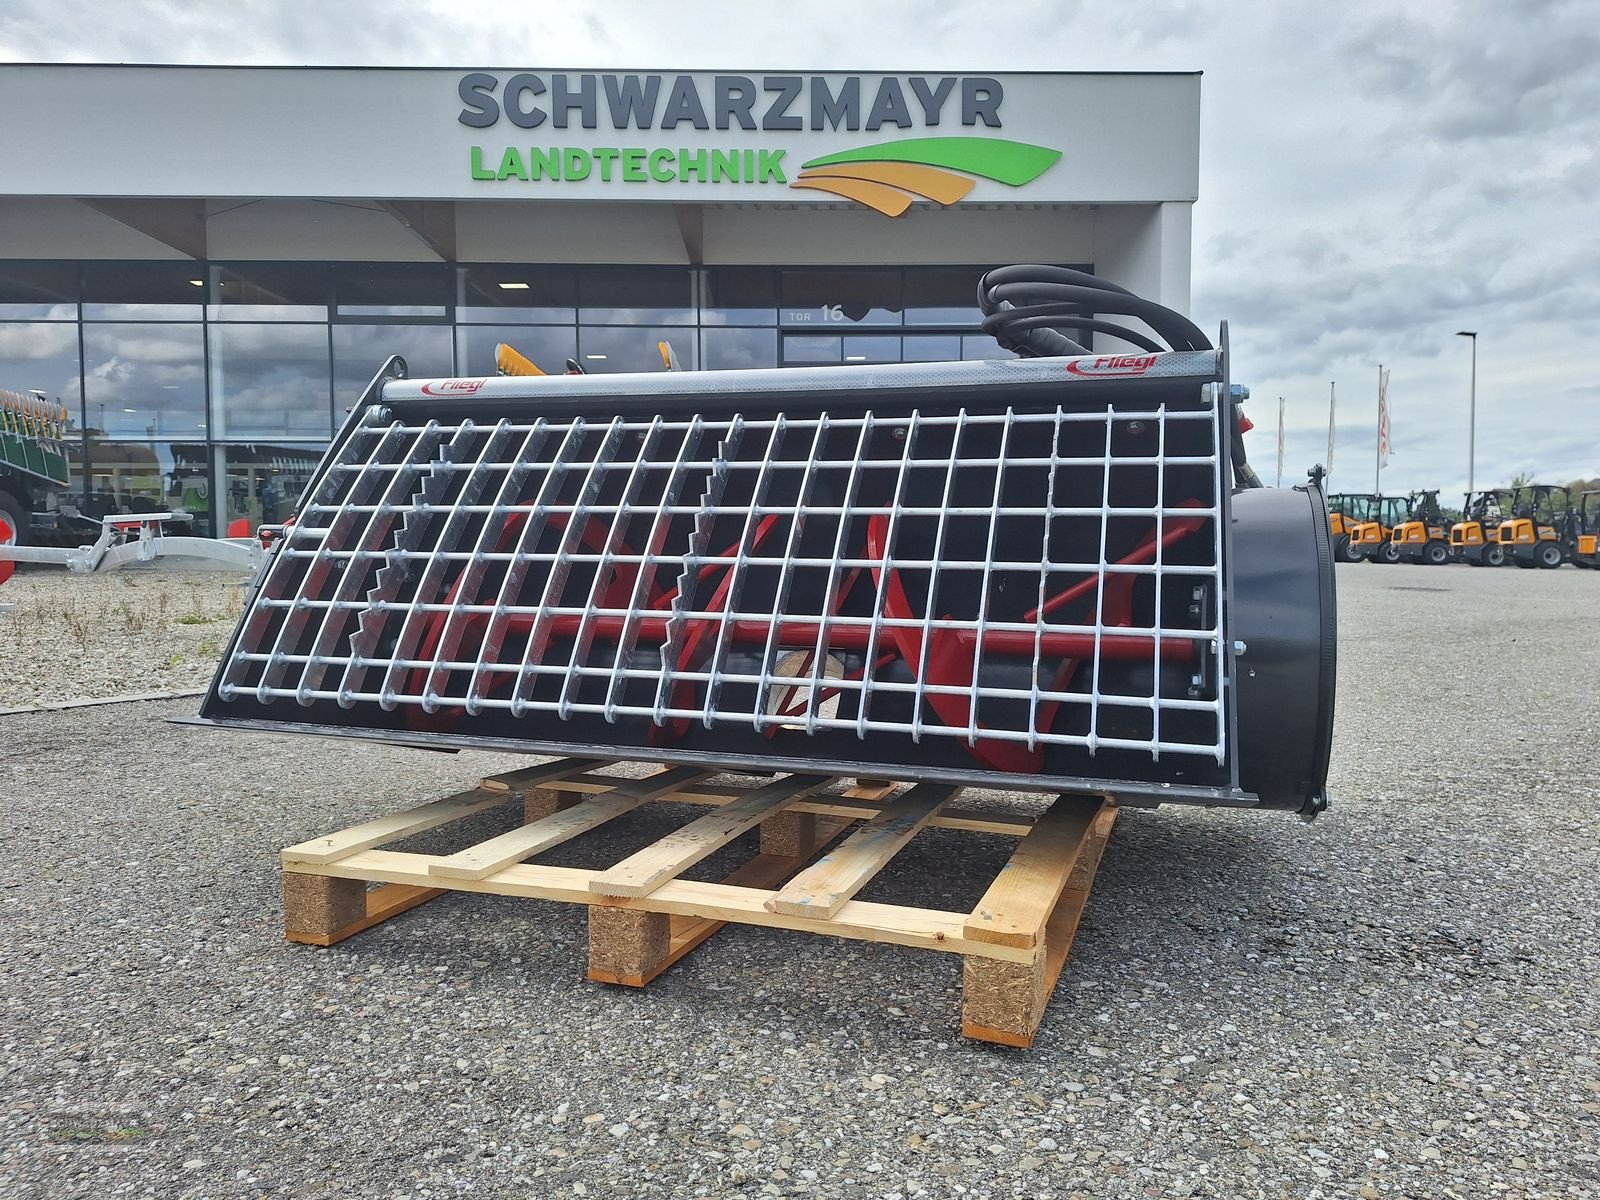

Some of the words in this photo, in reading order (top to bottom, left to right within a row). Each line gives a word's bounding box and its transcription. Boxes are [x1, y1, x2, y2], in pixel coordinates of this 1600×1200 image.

[457, 72, 1005, 132] SCHWARZMAYR
[470, 145, 787, 184] LANDTECHNIK
[789, 312, 811, 321] TOR
[820, 304, 845, 322] 16
[1093, 355, 1158, 372] Fliegl
[440, 378, 488, 393] Fliegl
